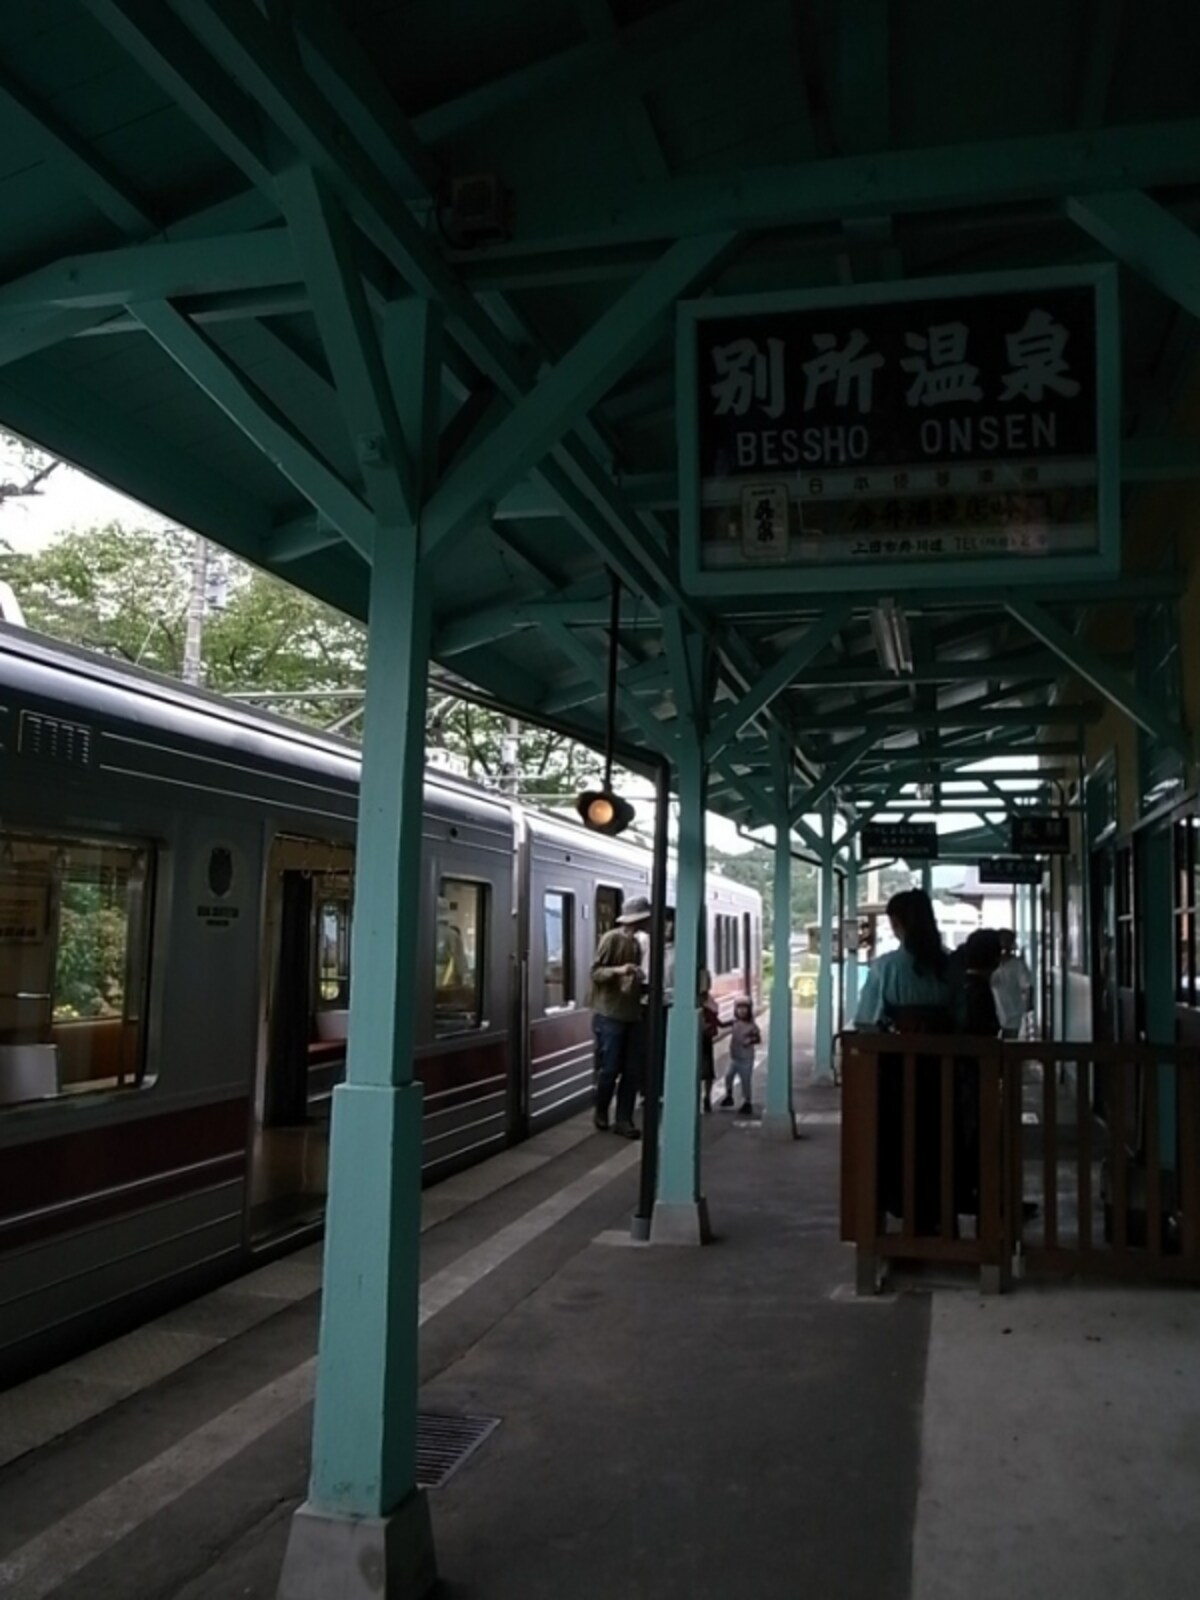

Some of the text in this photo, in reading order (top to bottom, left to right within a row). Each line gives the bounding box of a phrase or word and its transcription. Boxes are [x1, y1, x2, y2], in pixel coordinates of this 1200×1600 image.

[709, 307, 1082, 420] 別所温泉
[735, 411, 1058, 467] BESSHO ONSEN
